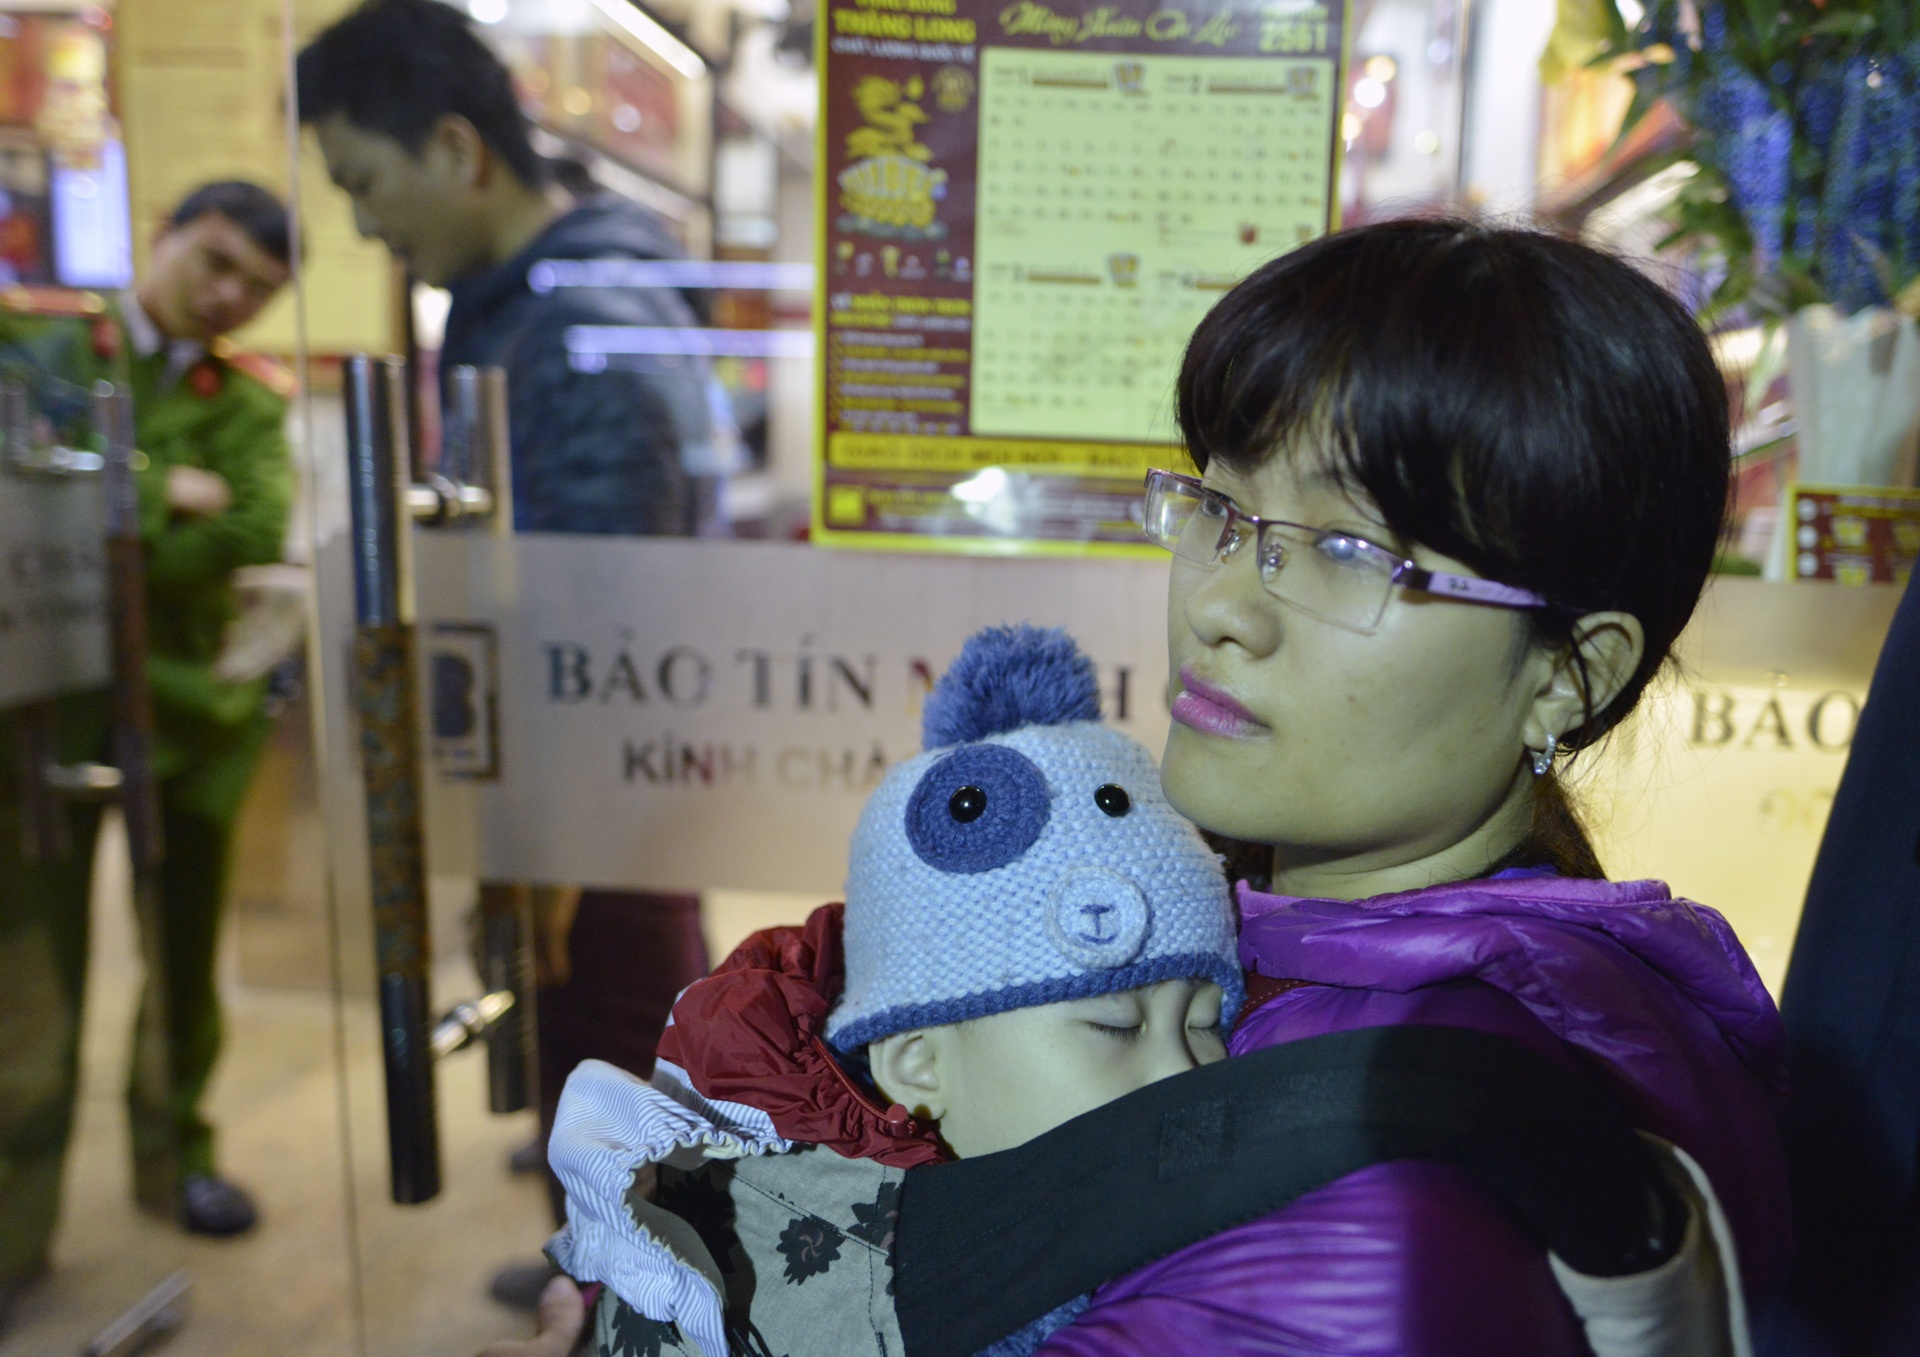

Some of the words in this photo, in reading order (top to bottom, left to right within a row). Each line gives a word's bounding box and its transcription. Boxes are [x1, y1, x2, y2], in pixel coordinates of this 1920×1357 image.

[544, 625, 710, 704] BẢO
[735, 632, 876, 709] TÍN
[621, 731, 757, 785] KÍNH
